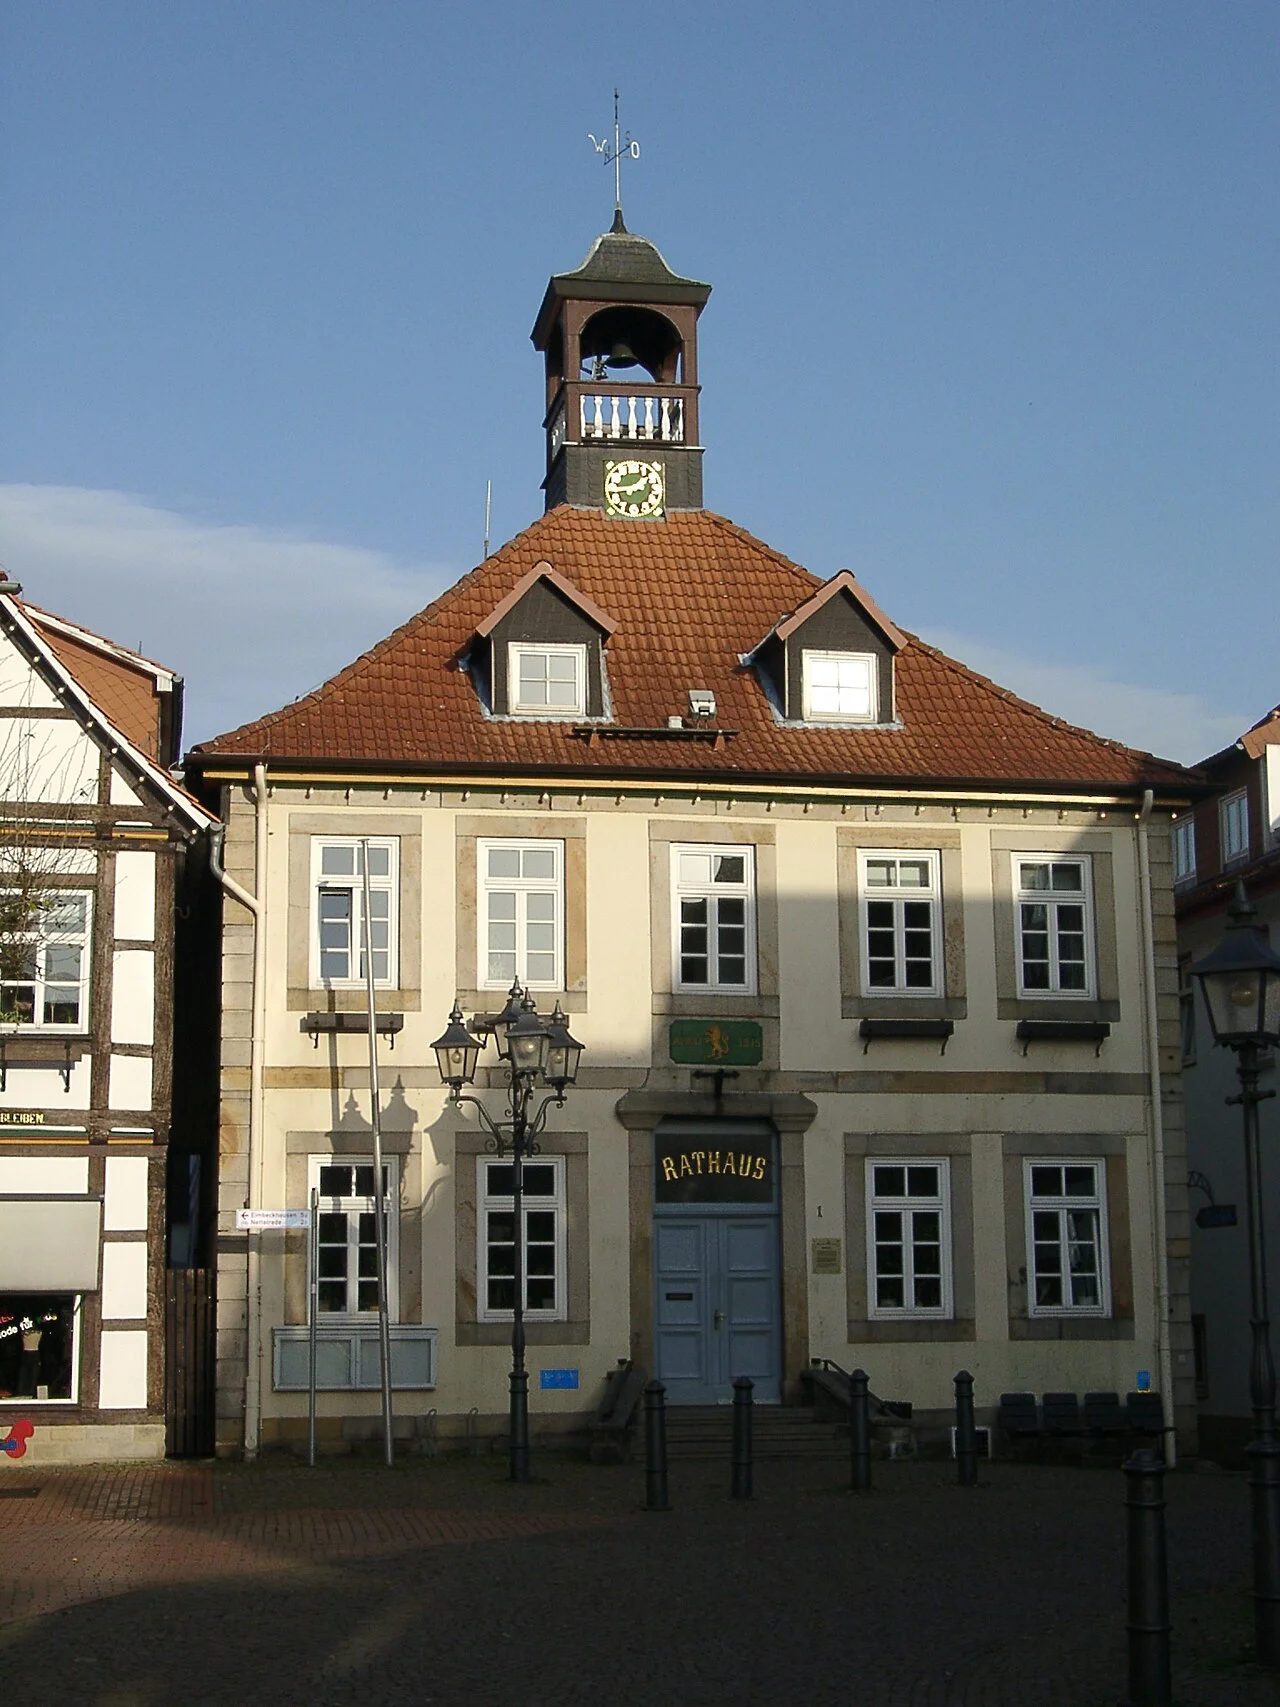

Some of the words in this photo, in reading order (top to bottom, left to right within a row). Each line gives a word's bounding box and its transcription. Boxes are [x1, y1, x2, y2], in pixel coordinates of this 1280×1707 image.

[588, 134, 607, 151] W
[662, 1151, 767, 1181] RATHAUS
[817, 1205, 824, 1218] 1
[0, 1326, 18, 1339] ode
